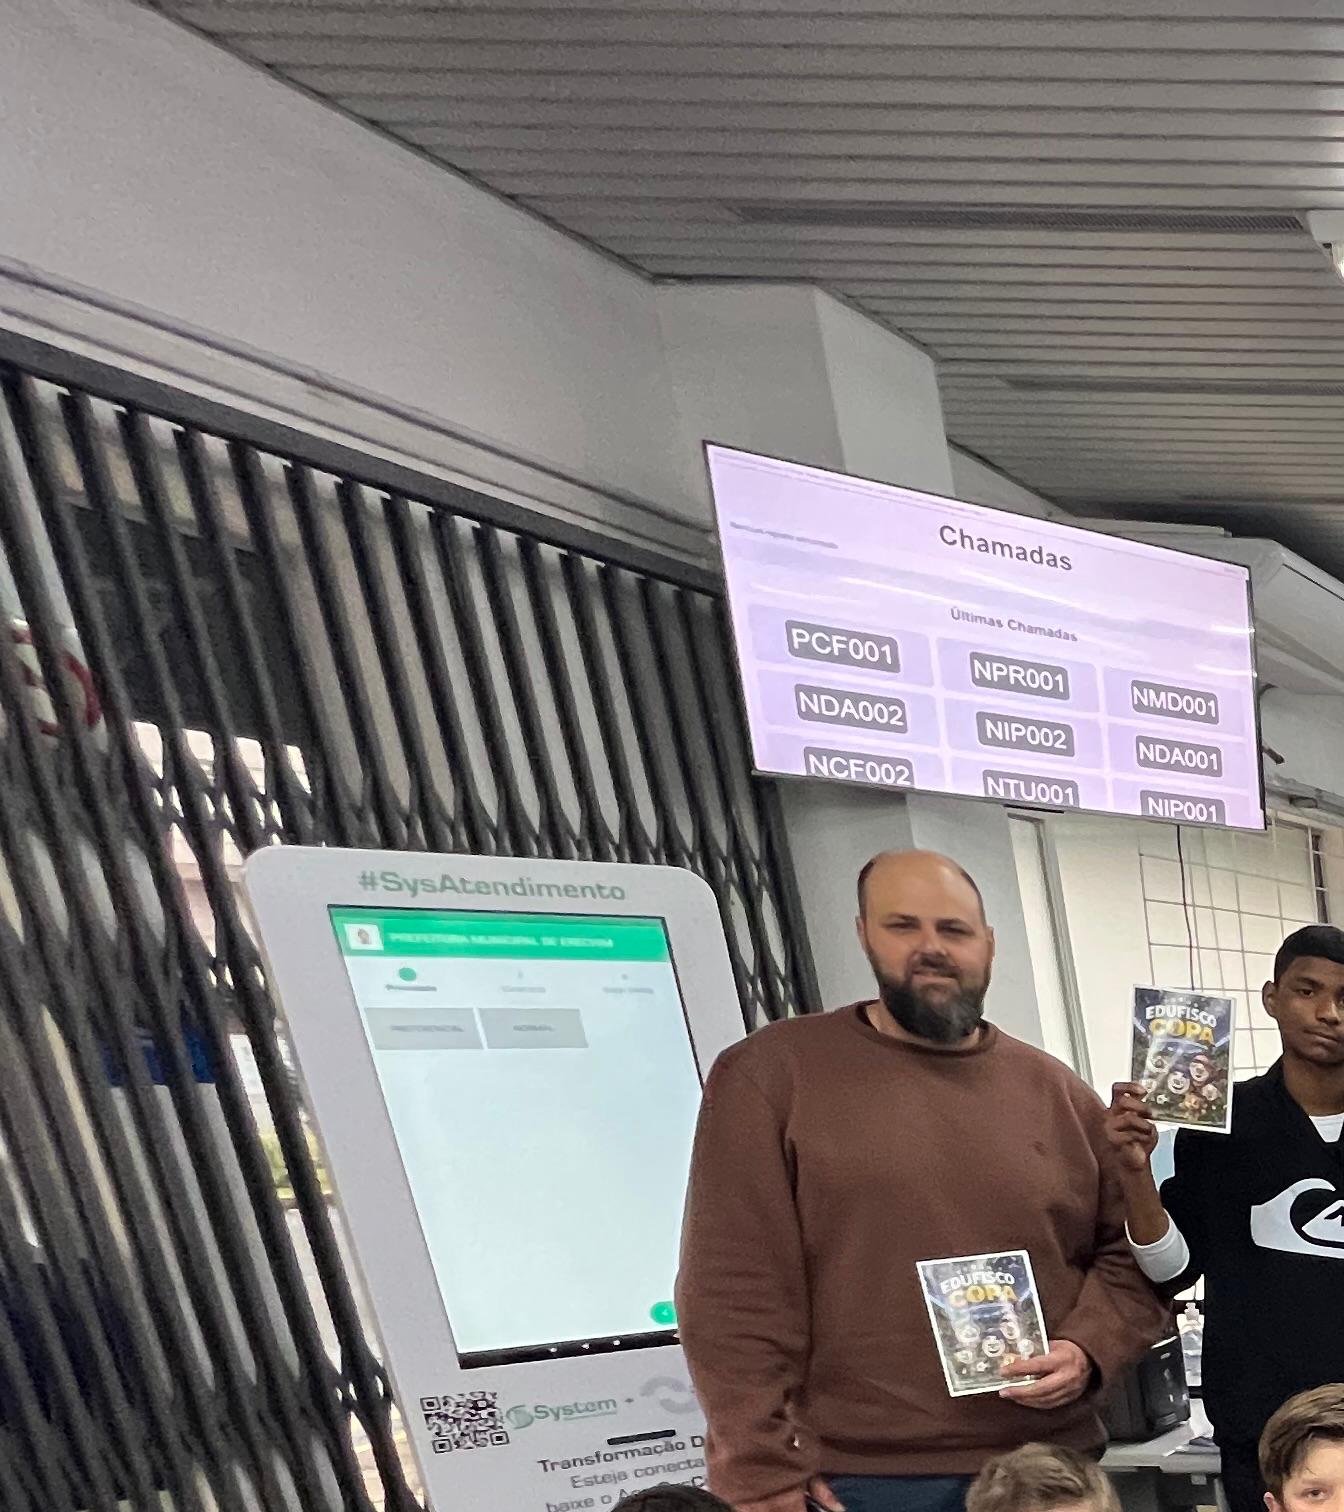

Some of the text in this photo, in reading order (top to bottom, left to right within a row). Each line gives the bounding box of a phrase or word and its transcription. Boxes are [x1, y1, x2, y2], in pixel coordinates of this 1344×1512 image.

[939, 524, 1073, 572] Chamadas
[950, 606, 1079, 642] Últimas Chamadas
[791, 627, 894, 664] PCF001
[973, 658, 1067, 694] NPR001
[799, 692, 904, 726] NDA002
[1133, 686, 1217, 718] NMD001
[985, 719, 1068, 751] NIP002
[809, 754, 911, 786] NCF002
[1139, 742, 1220, 772] NDA001
[987, 776, 1076, 806] NTU001
[1148, 798, 1219, 823] NIP001
[357, 868, 627, 901] #SysAtendimento
[1145, 1004, 1217, 1028] EDUFISCO
[1149, 1018, 1215, 1046] COPA
[940, 1271, 1015, 1294] EDUFISCO
[948, 1284, 1018, 1307] COPA
[534, 1397, 617, 1423] System
[538, 1439, 685, 1473] Transformação
[570, 1457, 705, 1489] Esteja conecta
